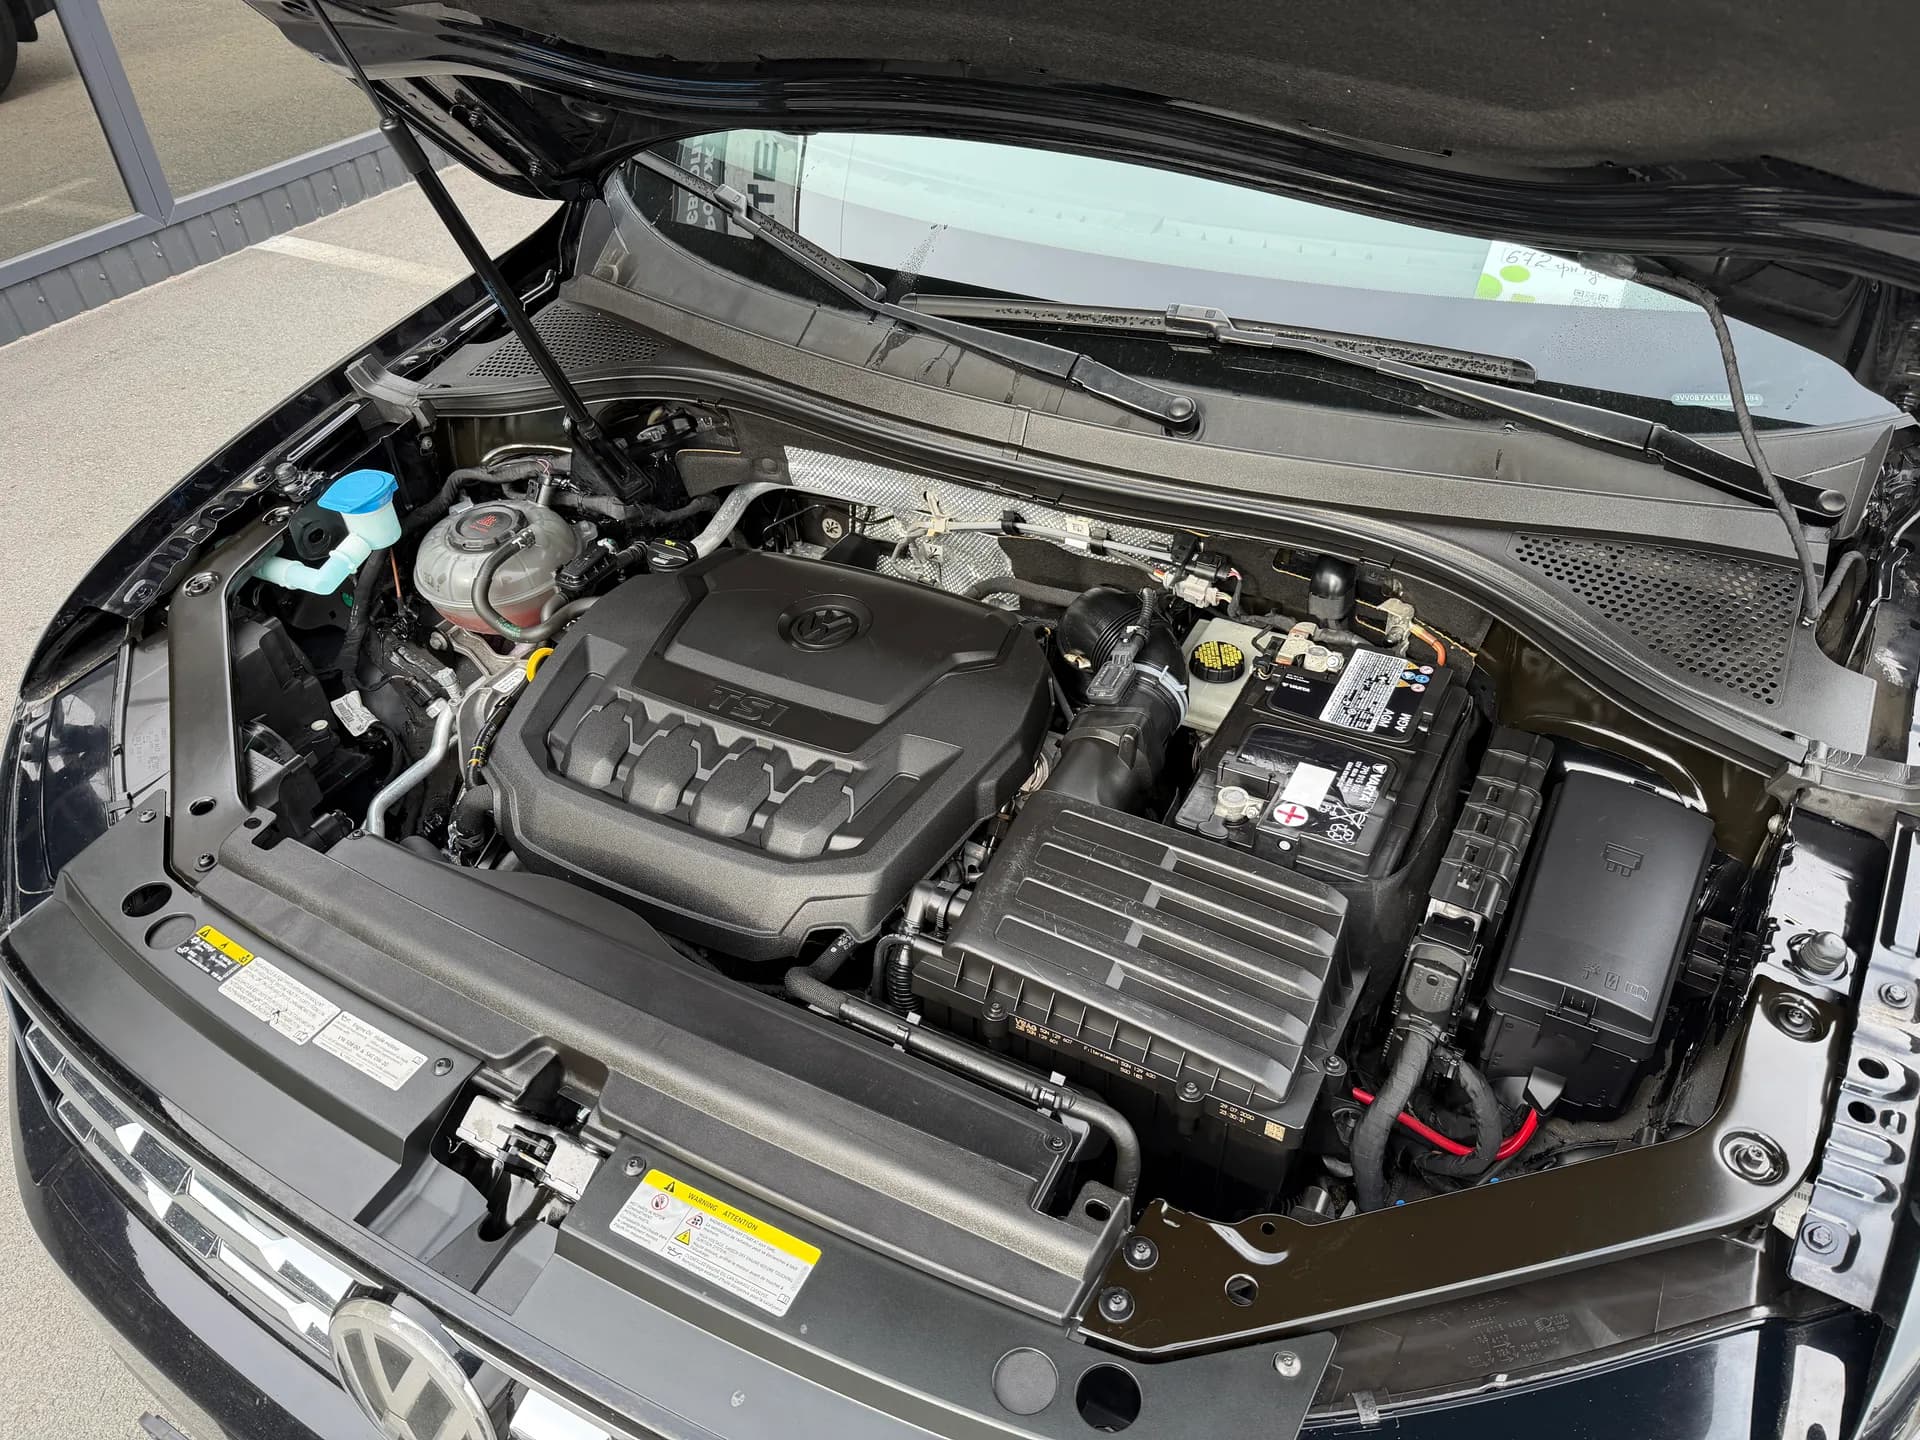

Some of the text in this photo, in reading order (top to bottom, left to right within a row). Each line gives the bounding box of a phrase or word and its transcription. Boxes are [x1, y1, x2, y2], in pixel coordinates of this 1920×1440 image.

[709, 685, 790, 726] TSI
[1394, 713, 1412, 733] AGM
[1359, 773, 1384, 803] VARTA
[688, 1192, 758, 1232] WARNING ATTENTION
